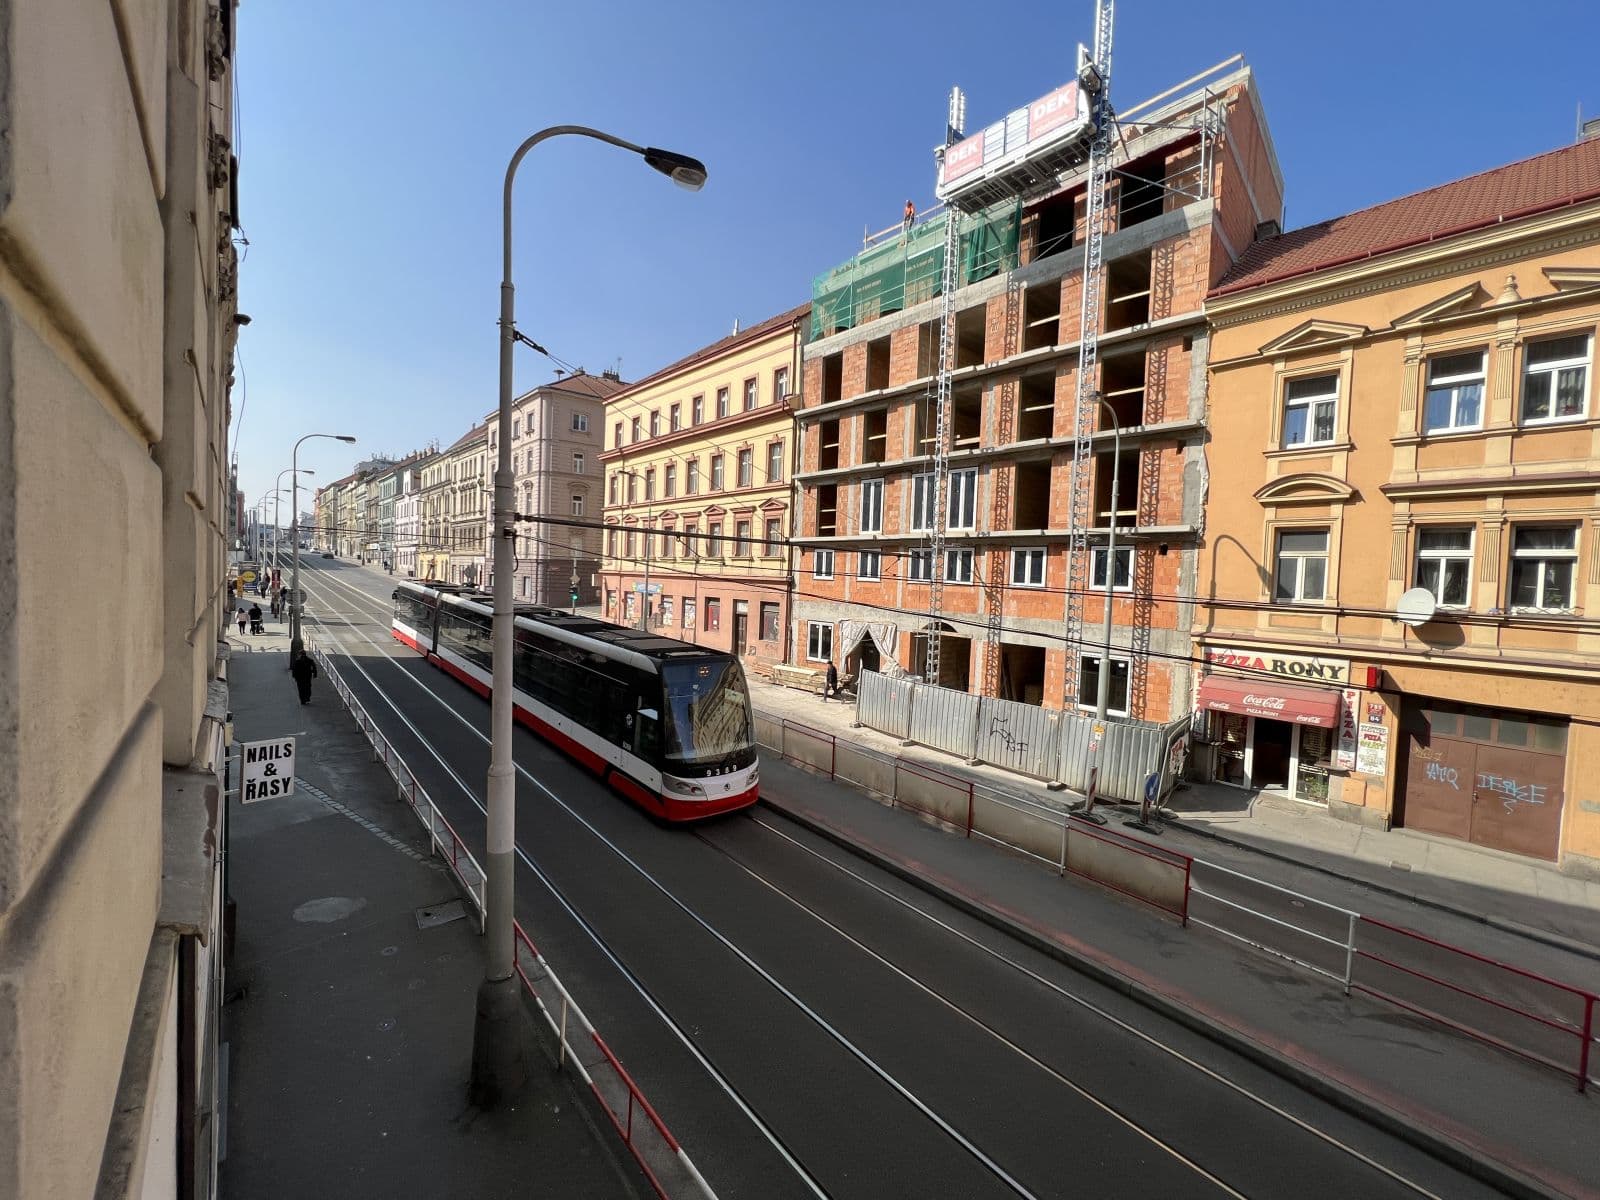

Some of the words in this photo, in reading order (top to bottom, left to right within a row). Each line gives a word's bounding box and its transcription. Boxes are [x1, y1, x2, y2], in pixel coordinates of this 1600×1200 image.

[1034, 89, 1071, 119] DEK
[949, 142, 978, 163] DEK
[1271, 659, 1344, 680] RONY
[1342, 691, 1355, 739] PIZZA
[247, 743, 292, 763] NAILS
[264, 763, 277, 776] &
[246, 777, 291, 800] ŘASY
